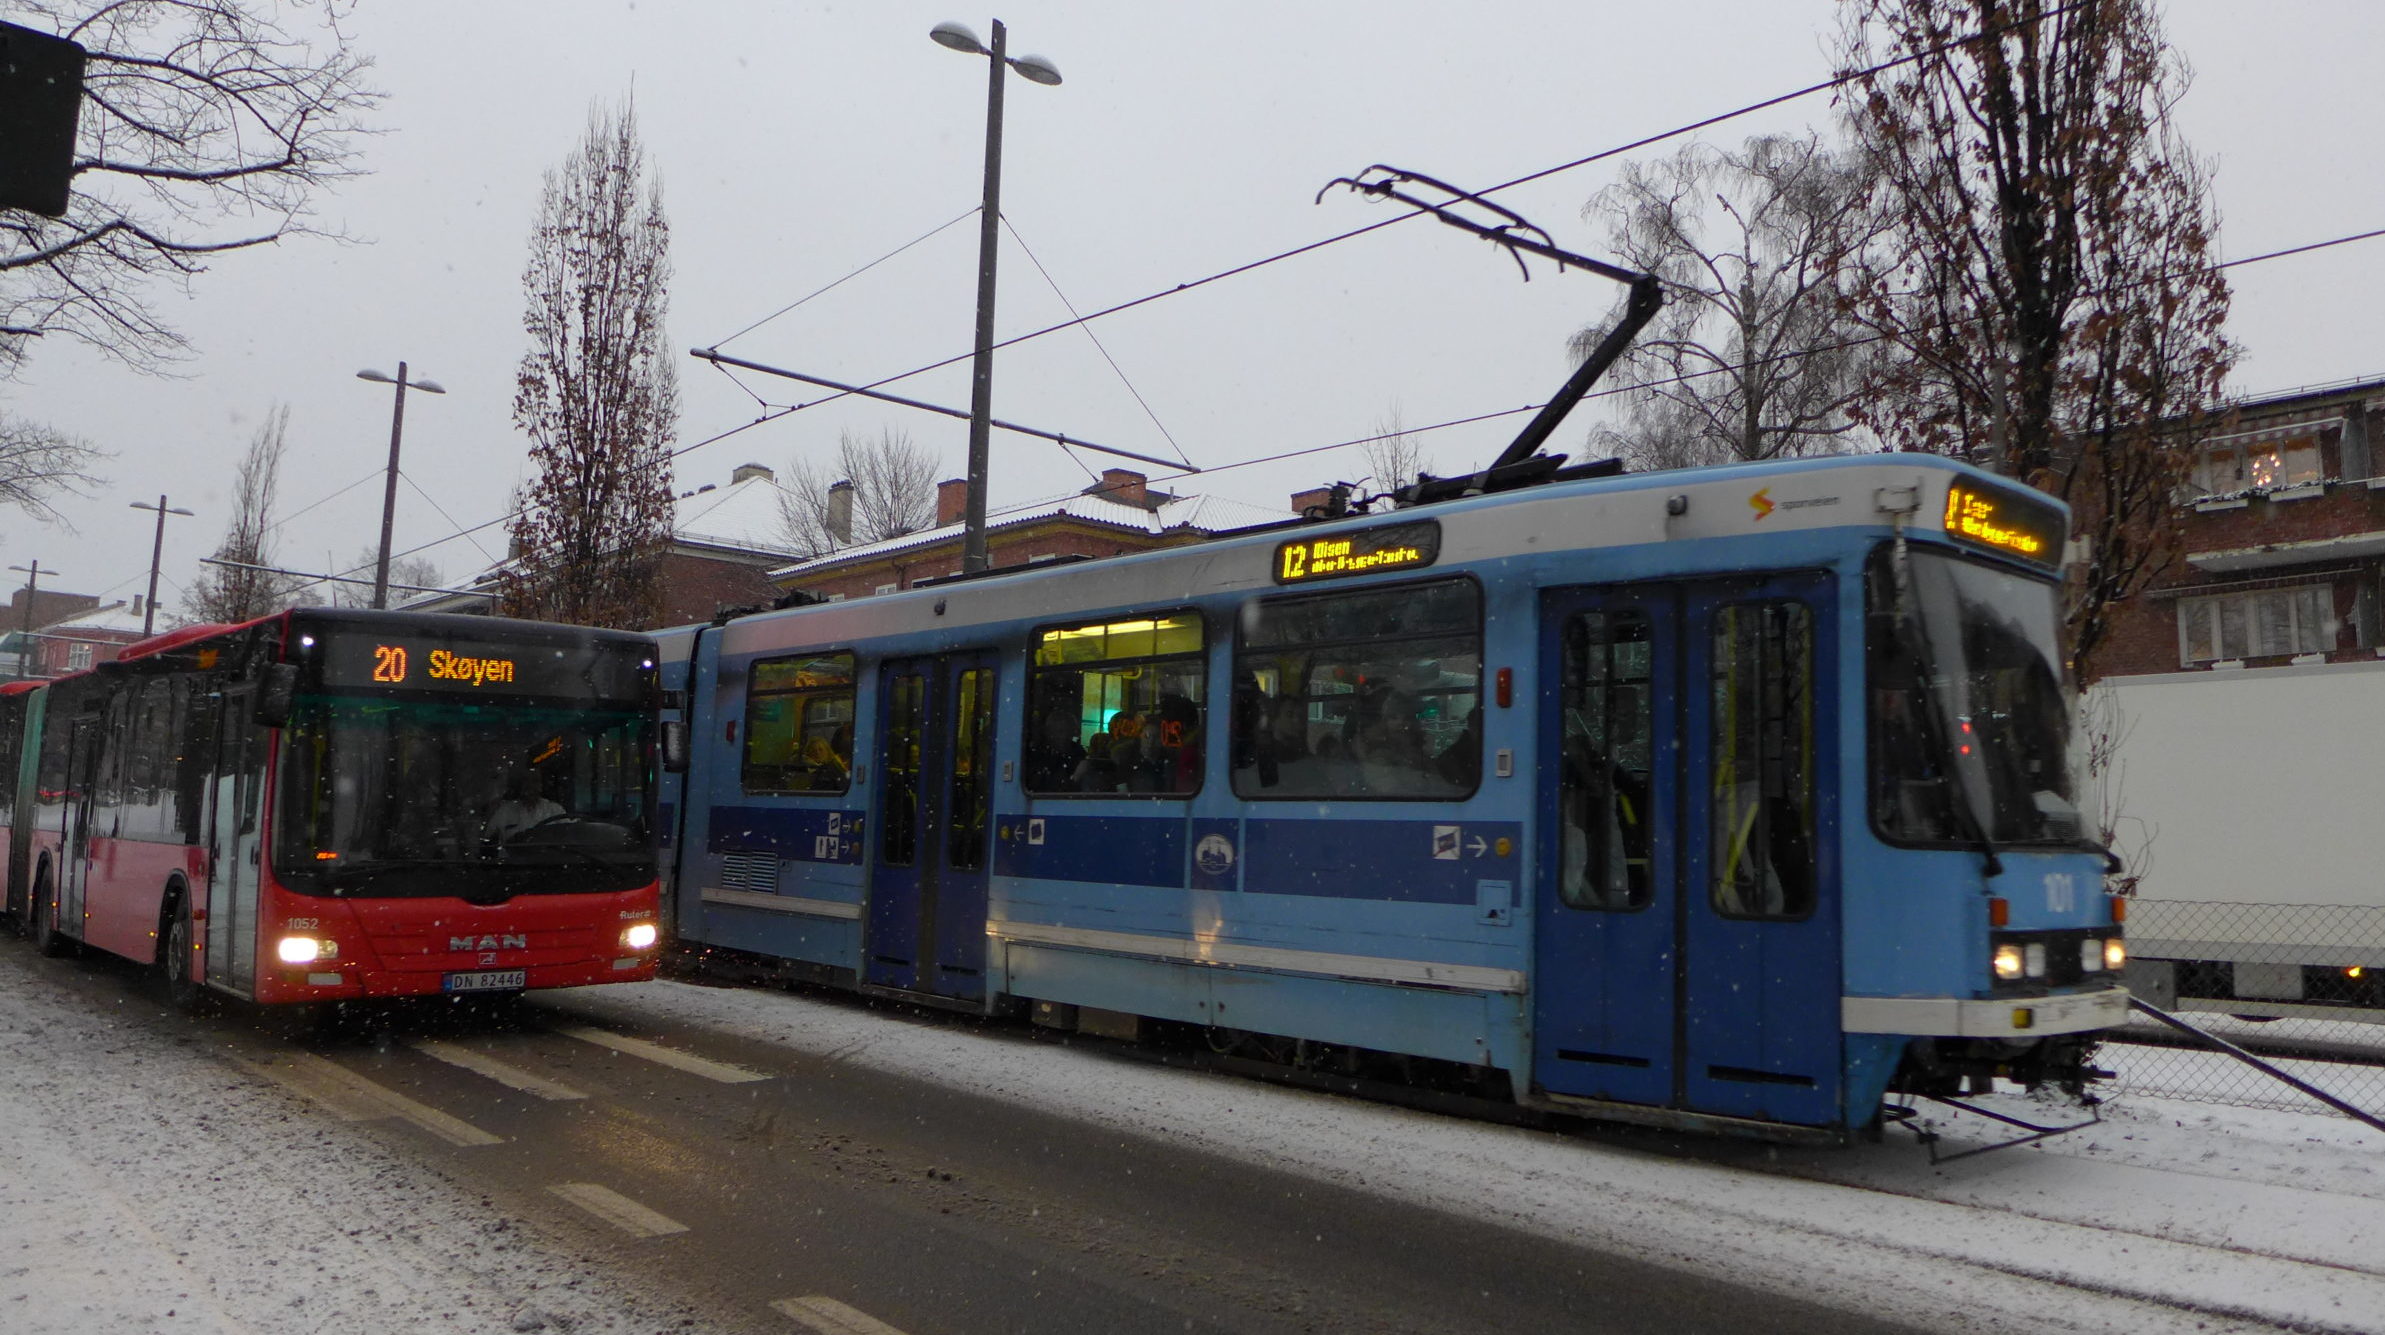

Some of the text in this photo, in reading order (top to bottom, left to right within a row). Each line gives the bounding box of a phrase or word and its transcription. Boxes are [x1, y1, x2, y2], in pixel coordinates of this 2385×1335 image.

[1283, 545, 1307, 578] 12
[373, 646, 515, 687] 20 Skøyen
[2044, 872, 2074, 913] 101
[288, 917, 319, 930] 1052
[449, 933, 526, 951] MAN
[454, 972, 523, 988] DN 82446
